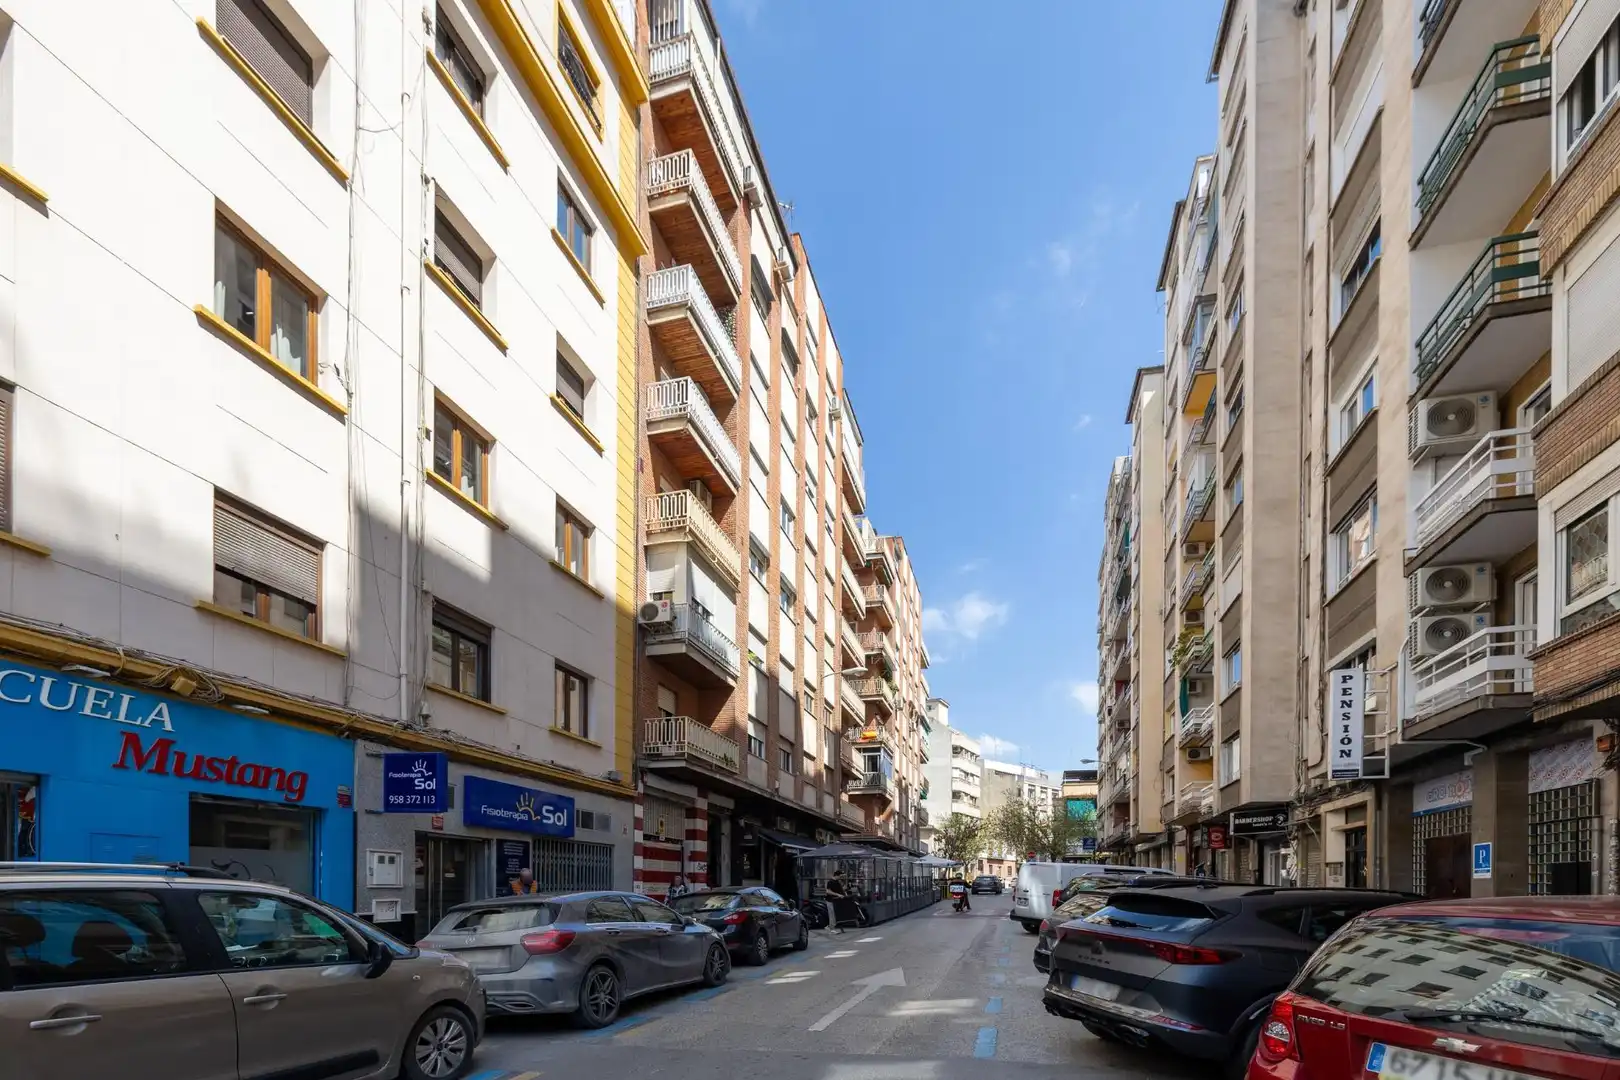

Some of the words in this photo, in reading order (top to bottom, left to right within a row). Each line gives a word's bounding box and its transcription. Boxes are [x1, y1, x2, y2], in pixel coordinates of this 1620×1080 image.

[1339, 674, 1354, 759] PENSIÓN
[111, 730, 309, 801] Mustang
[414, 778, 436, 790] Sol
[388, 795, 404, 804] 958
[406, 795, 421, 804] 372
[423, 795, 436, 804] 113
[481, 804, 529, 822] Fisioterapia
[542, 804, 567, 827] Sol
